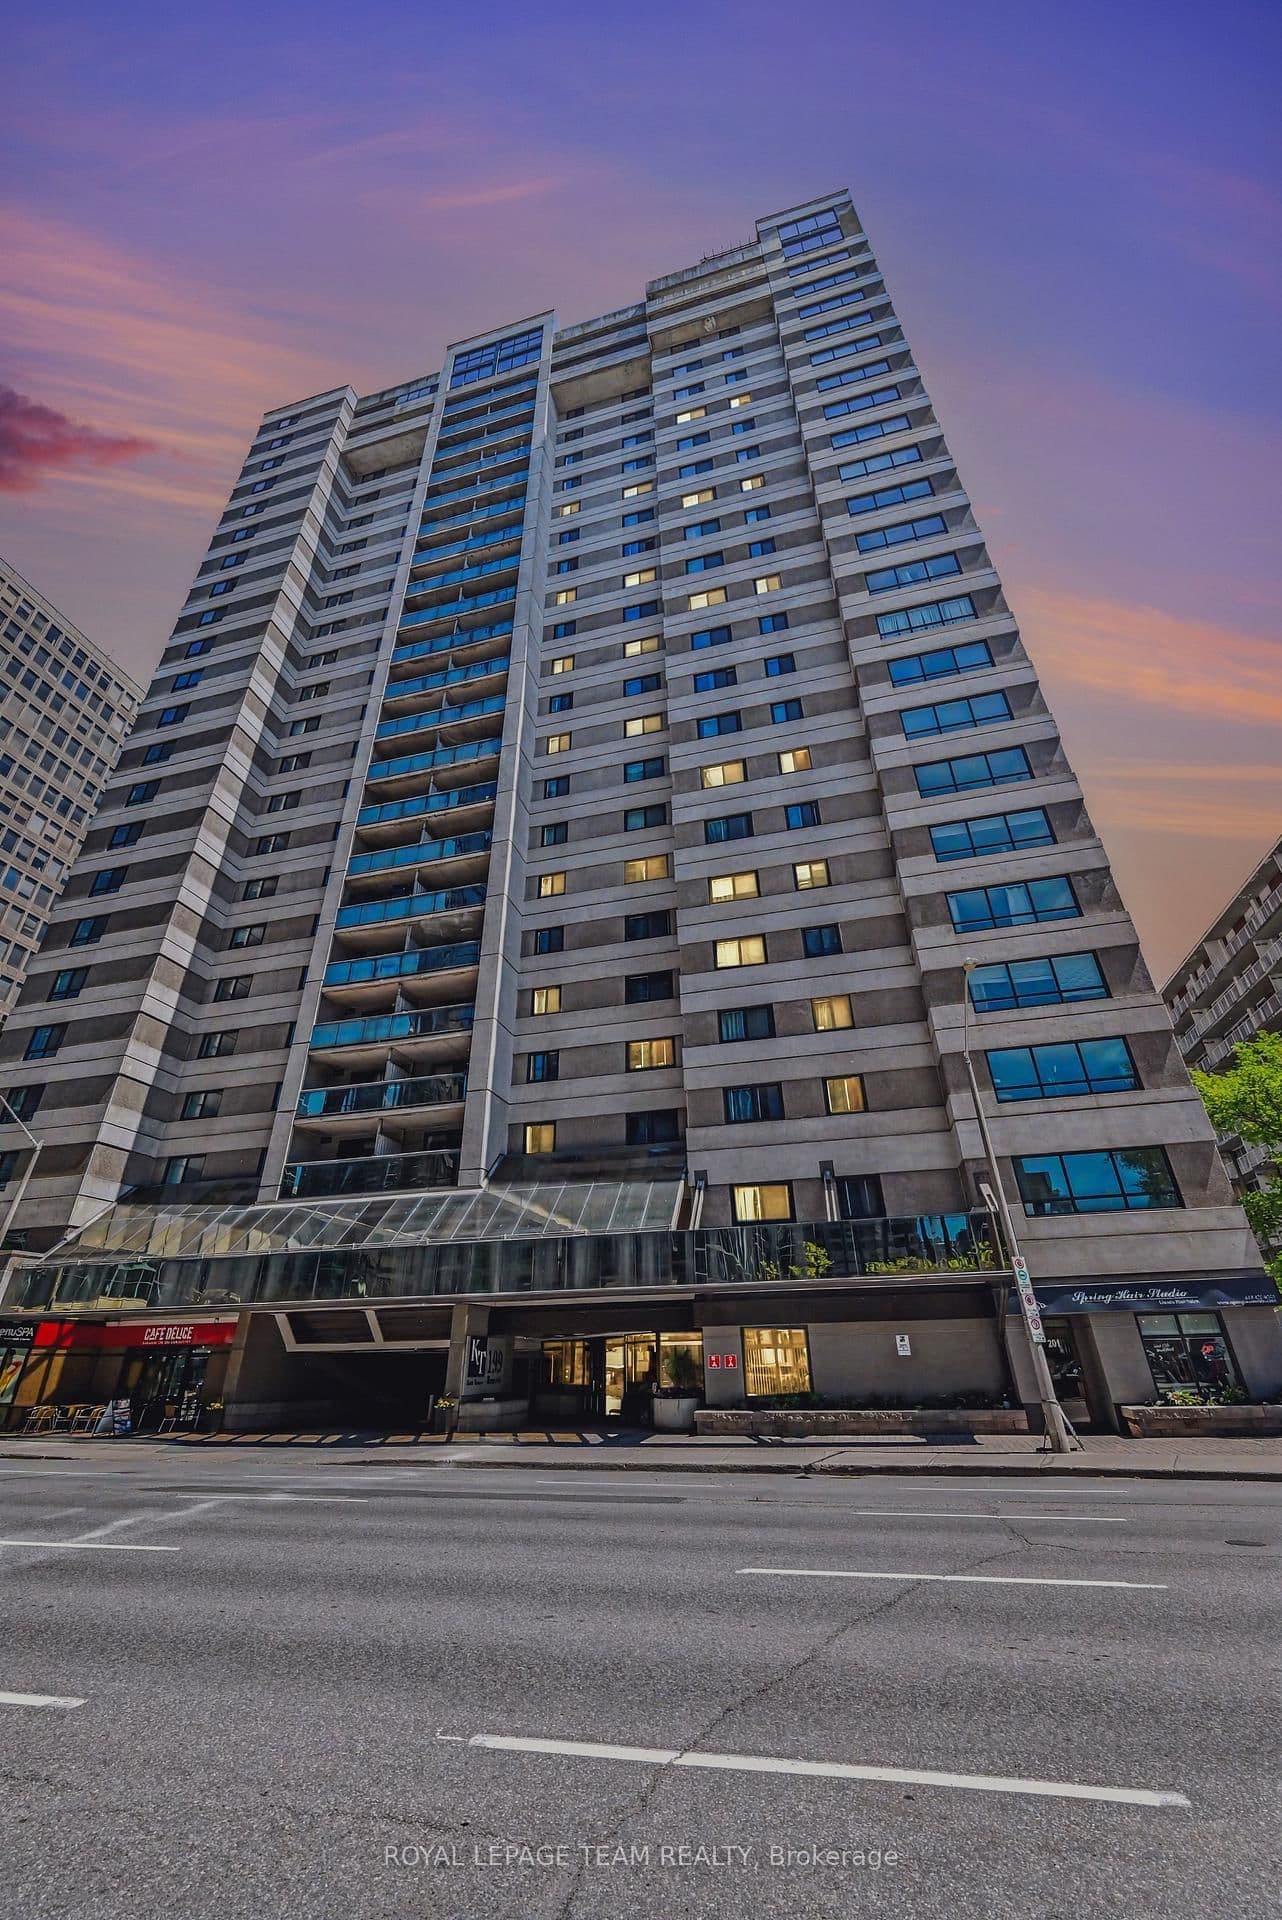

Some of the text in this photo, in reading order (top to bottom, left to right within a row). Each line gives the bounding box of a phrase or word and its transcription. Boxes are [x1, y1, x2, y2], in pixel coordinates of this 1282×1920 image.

[1072, 1288, 1188, 1304] Spring Hair Studio
